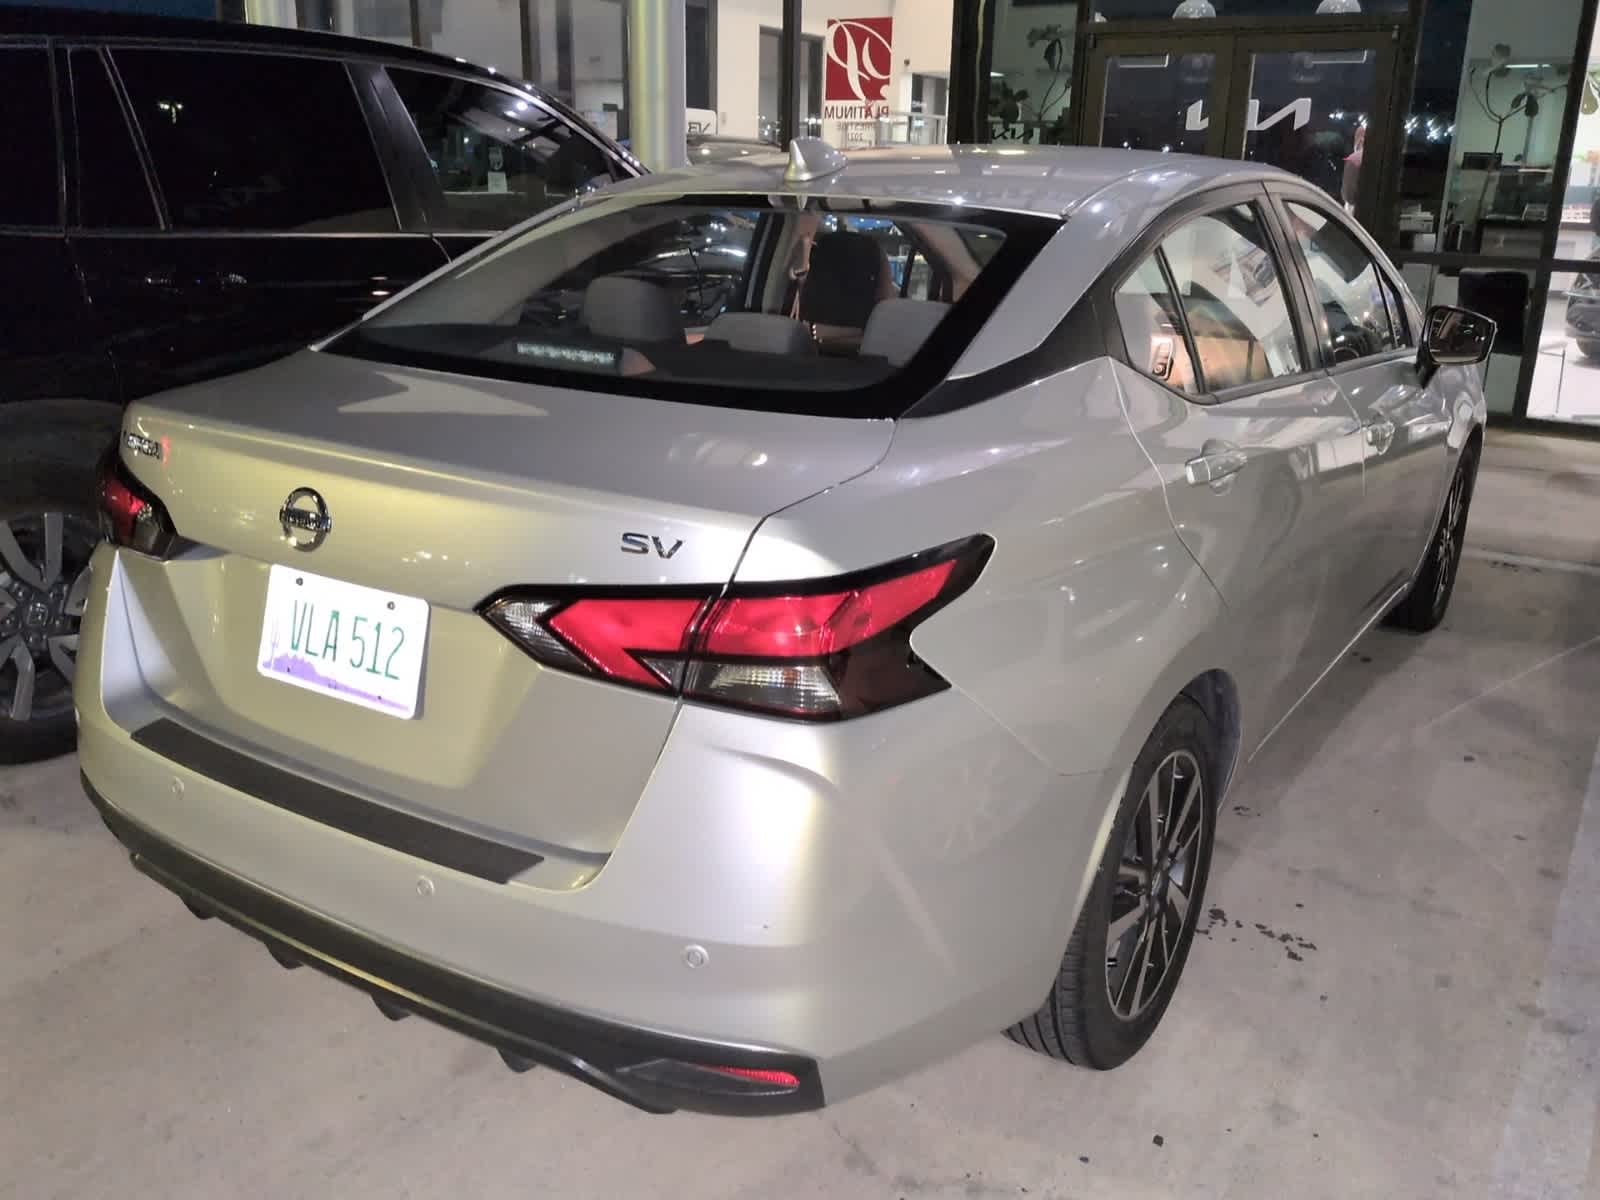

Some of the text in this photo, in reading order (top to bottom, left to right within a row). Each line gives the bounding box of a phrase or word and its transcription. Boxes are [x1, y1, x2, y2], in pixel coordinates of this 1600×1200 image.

[620, 531, 684, 559] SV
[290, 599, 405, 680] VLA 512
